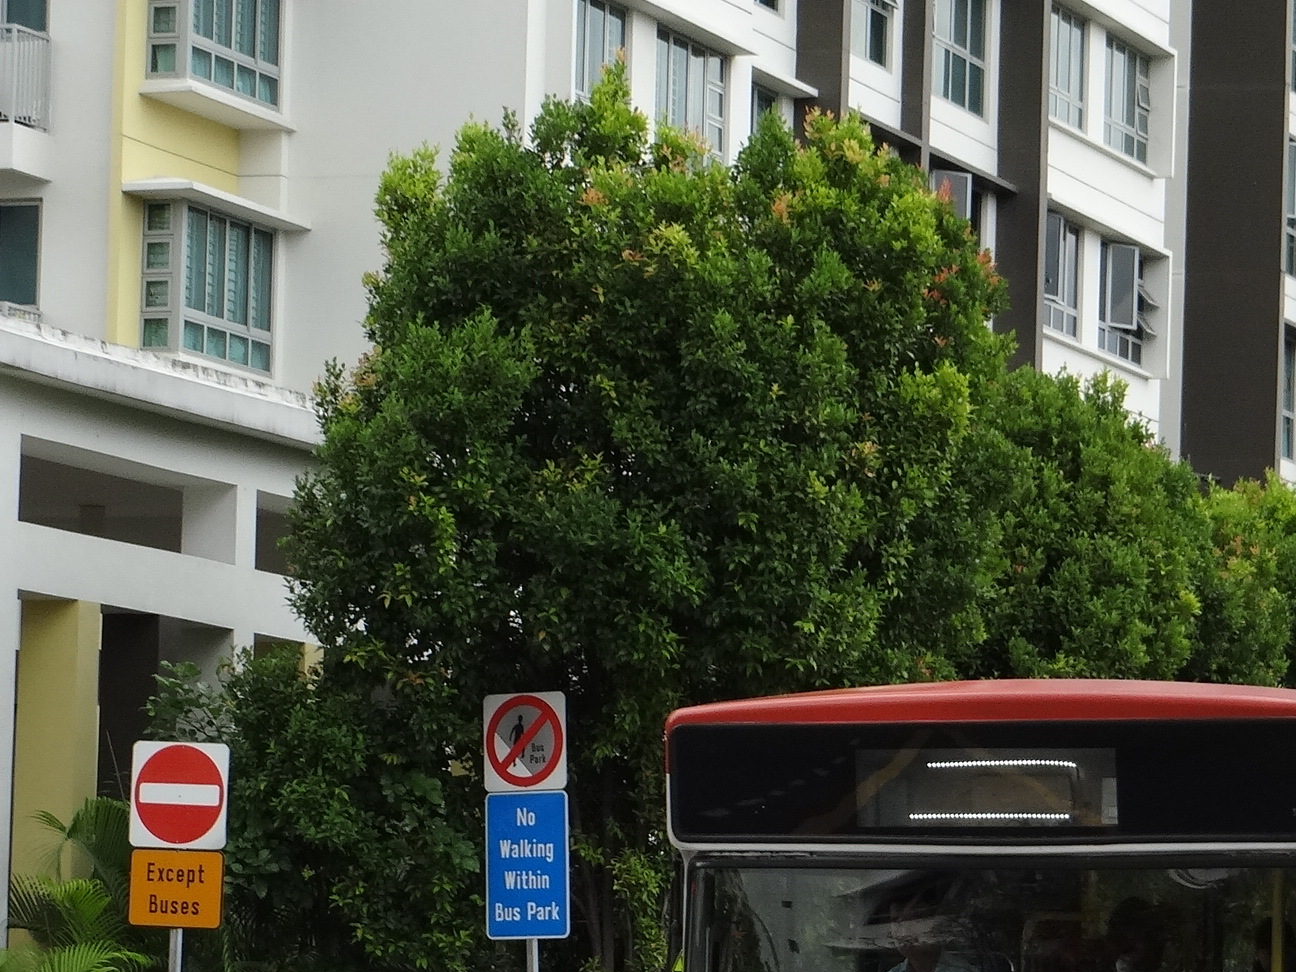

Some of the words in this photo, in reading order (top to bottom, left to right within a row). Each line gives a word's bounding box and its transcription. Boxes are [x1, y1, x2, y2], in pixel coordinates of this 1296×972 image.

[531, 742, 545, 753] Bus
[529, 753, 547, 764] Park
[516, 807, 536, 827] No
[499, 839, 554, 863] Walking
[146, 862, 205, 889] Except
[504, 870, 550, 890] Within
[148, 894, 200, 916] Buses
[495, 902, 521, 922] Bus
[526, 901, 560, 922] Park
